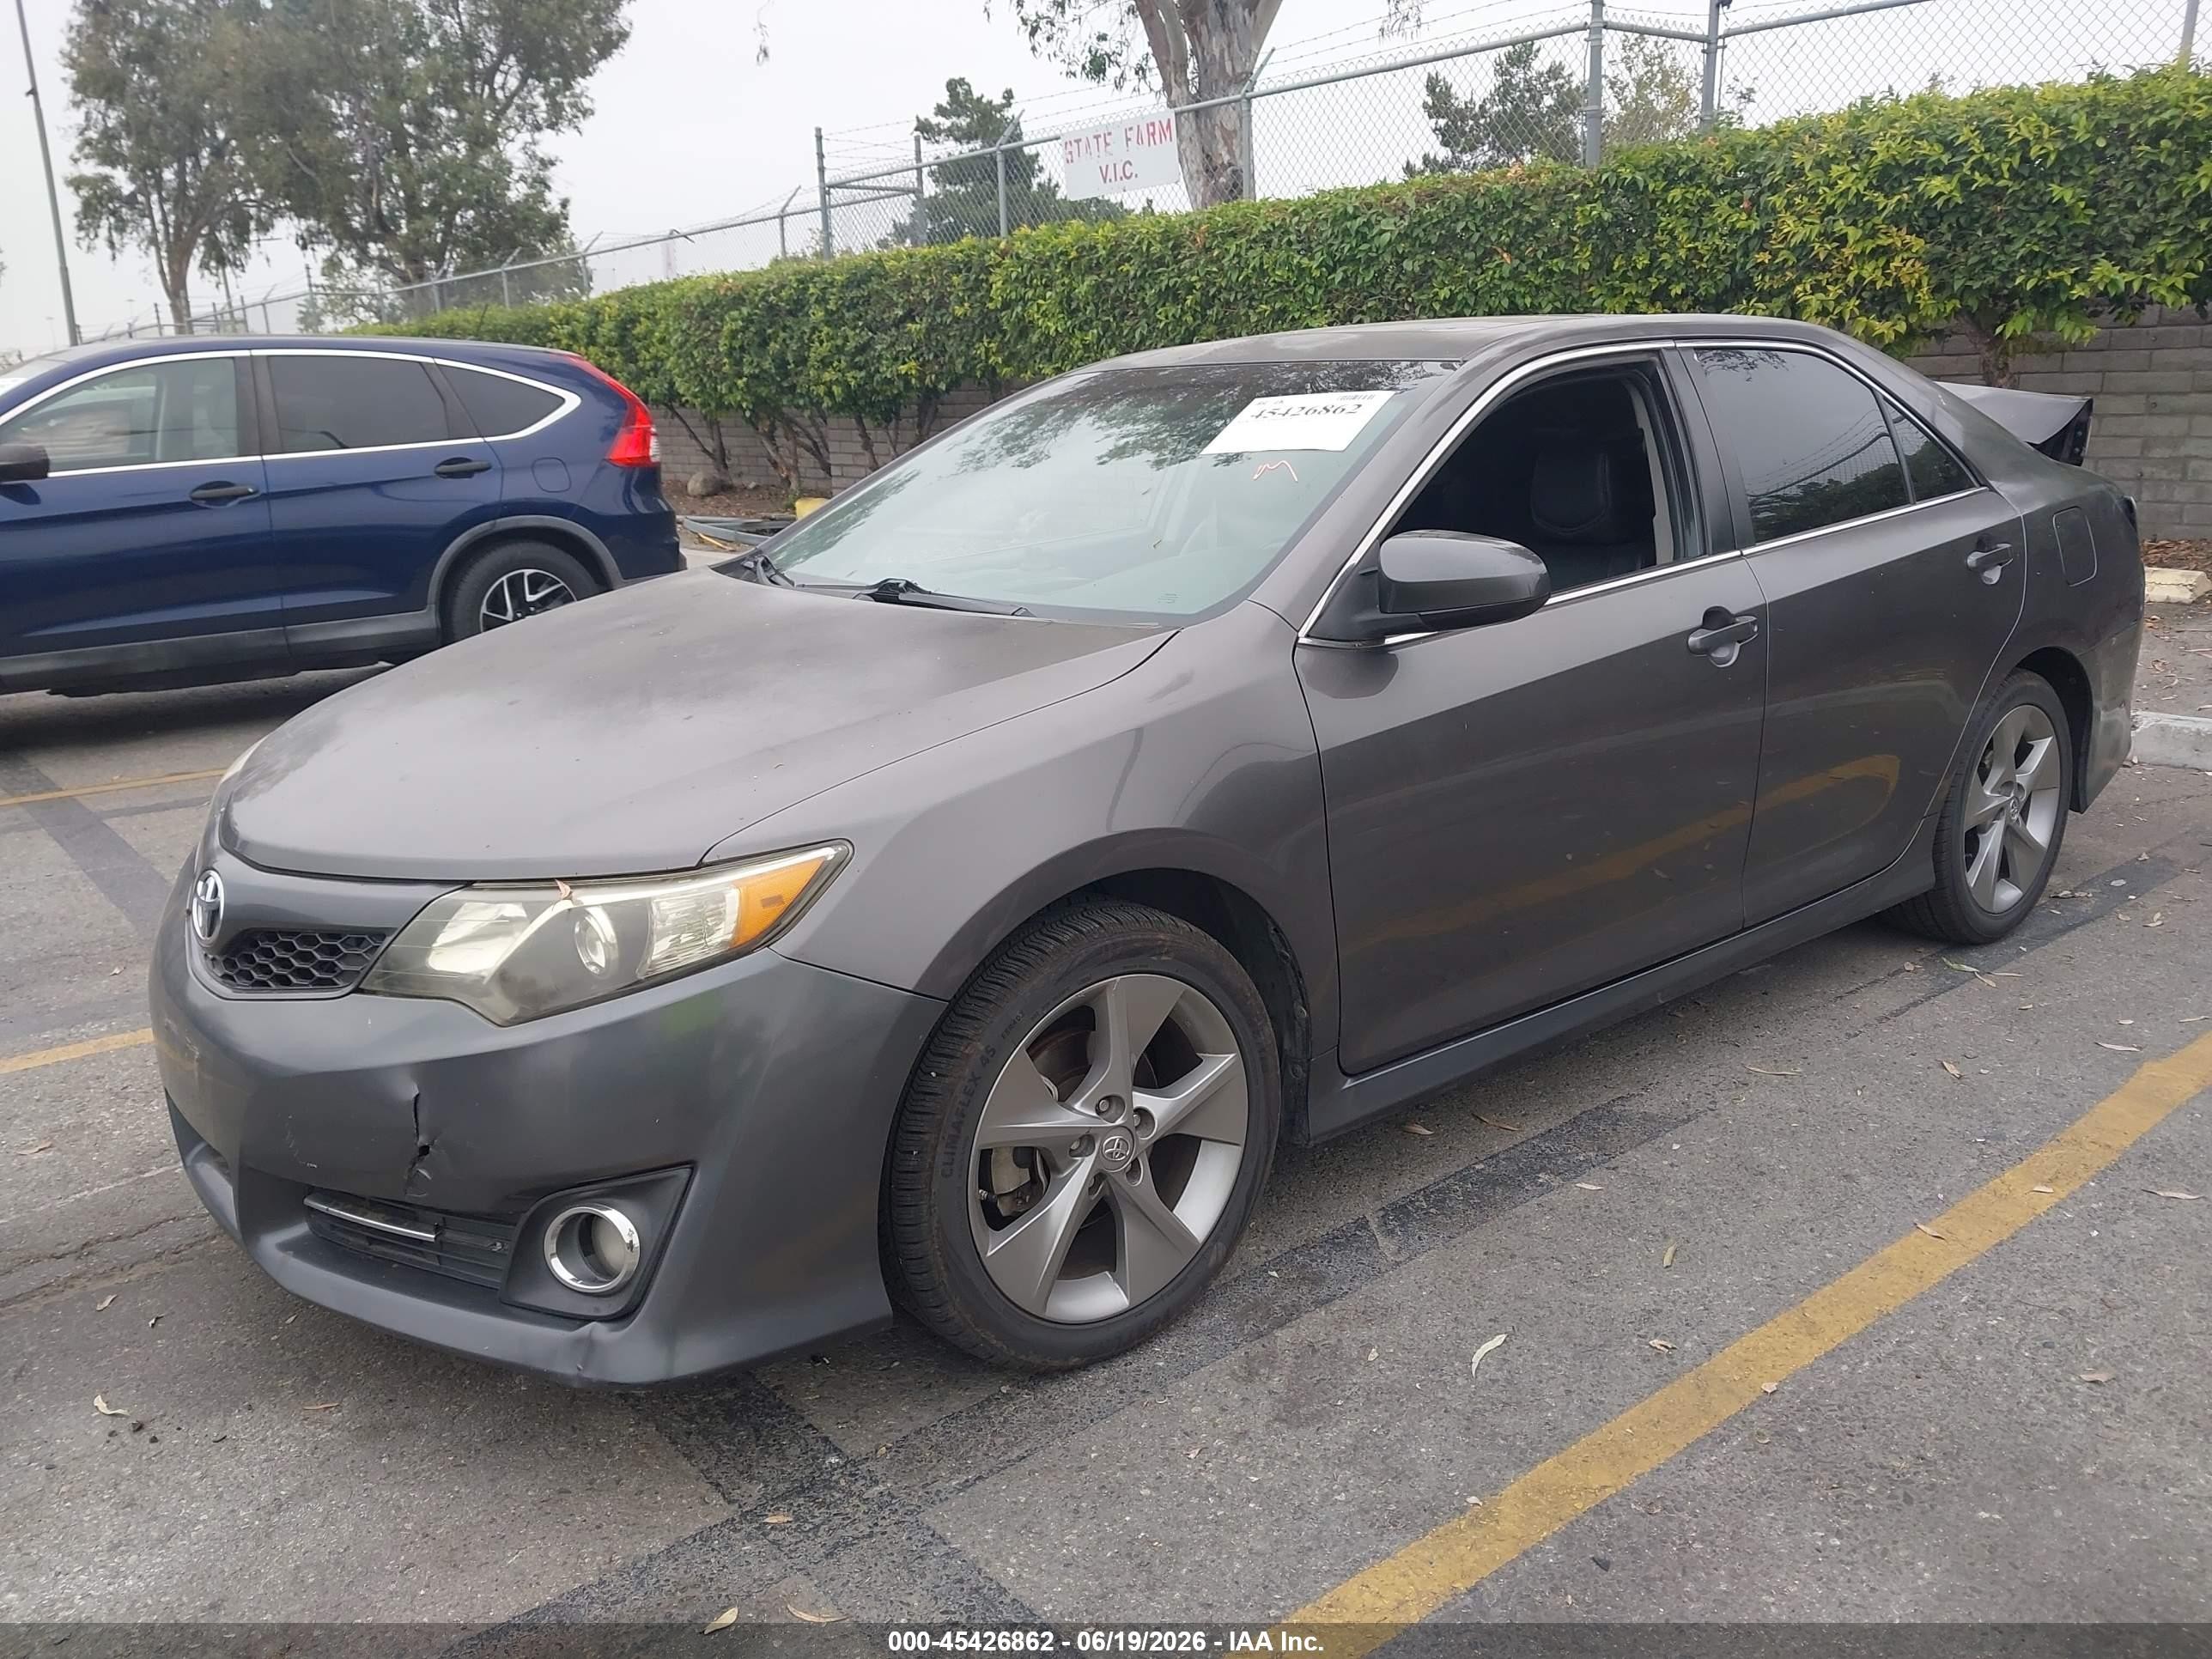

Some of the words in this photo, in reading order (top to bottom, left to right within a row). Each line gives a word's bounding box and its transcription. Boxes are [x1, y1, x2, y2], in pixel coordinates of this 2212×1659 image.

[1064, 131, 1113, 164] STATE
[1125, 118, 1173, 152] FARM
[1099, 160, 1139, 185] V.I.C.
[1250, 404, 1363, 419] 45426862
